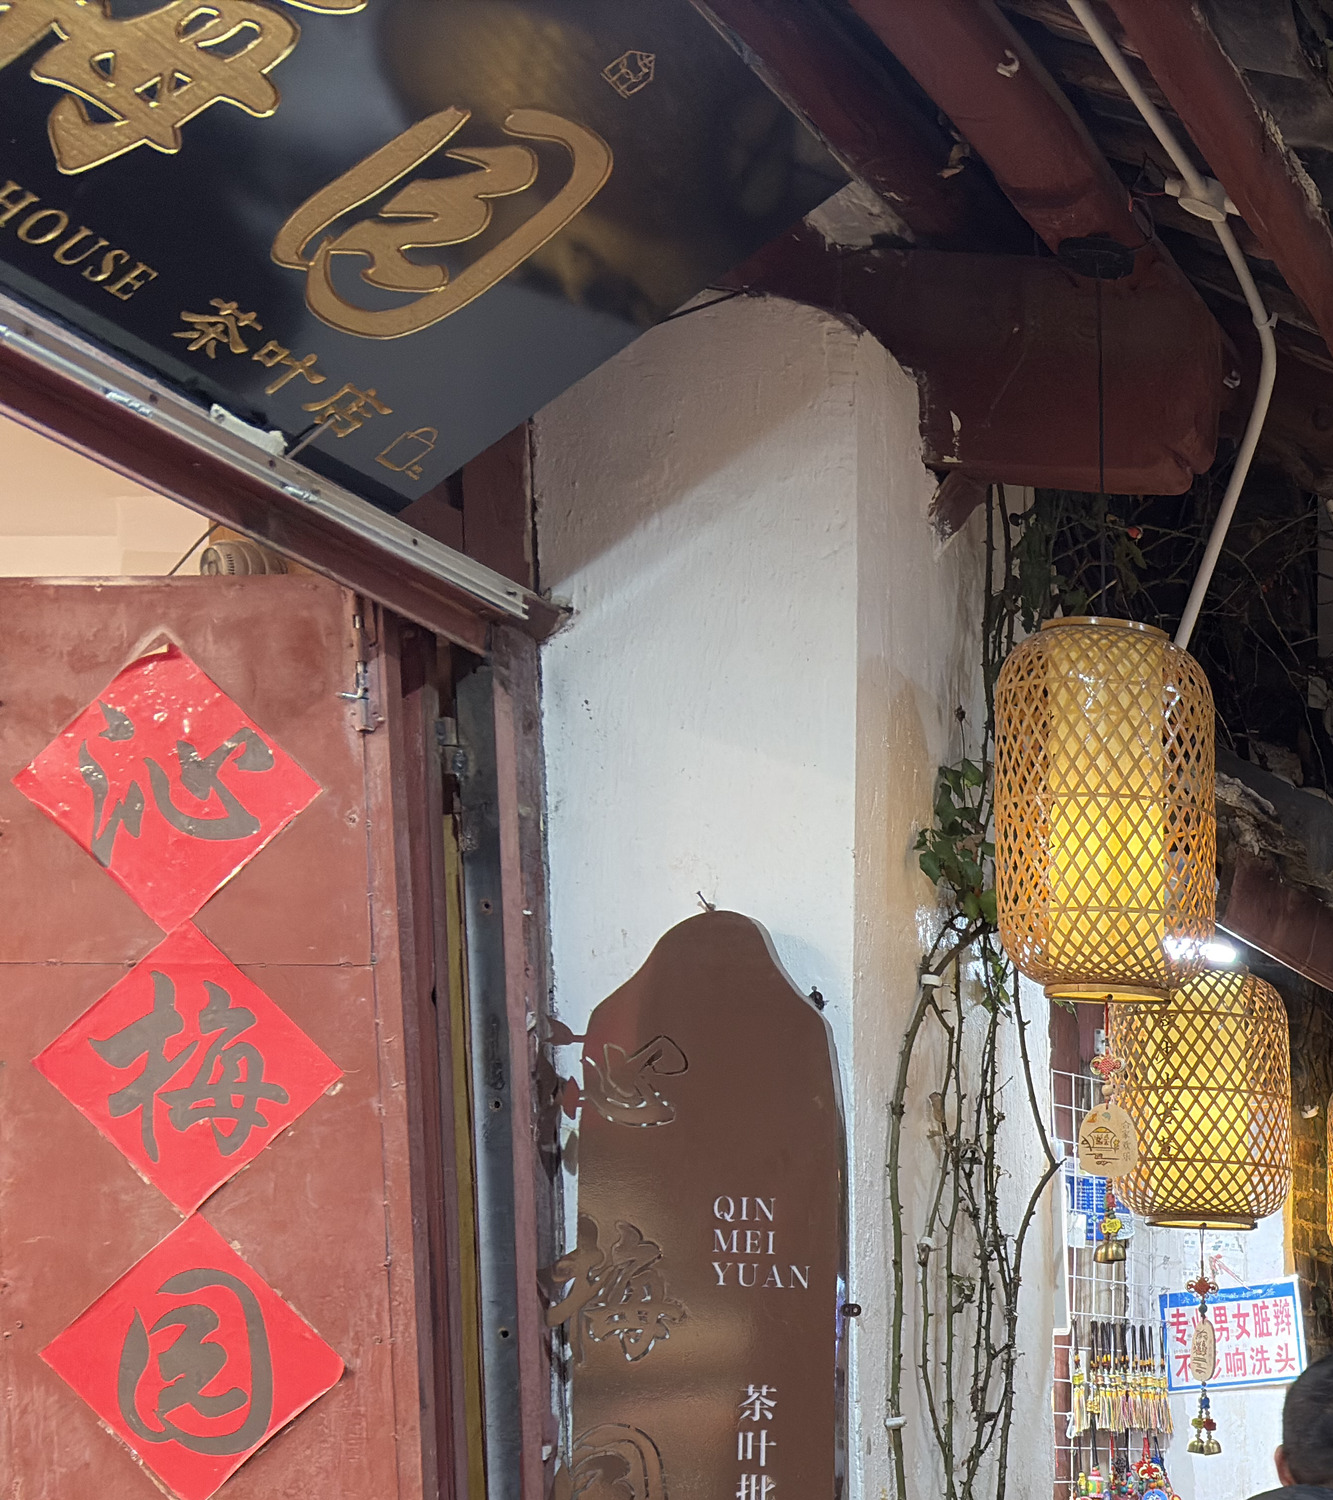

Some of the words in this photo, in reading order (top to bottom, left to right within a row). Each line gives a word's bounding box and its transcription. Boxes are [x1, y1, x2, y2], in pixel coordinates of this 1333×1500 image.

[0, 180, 159, 301] HOUSE
[172, 297, 392, 438] 茶叶店
[713, 1194, 776, 1222] QIN
[713, 1229, 777, 1255] MEI
[713, 1262, 811, 1289] YUAN
[1175, 1342, 1296, 1382] 不响洗头
